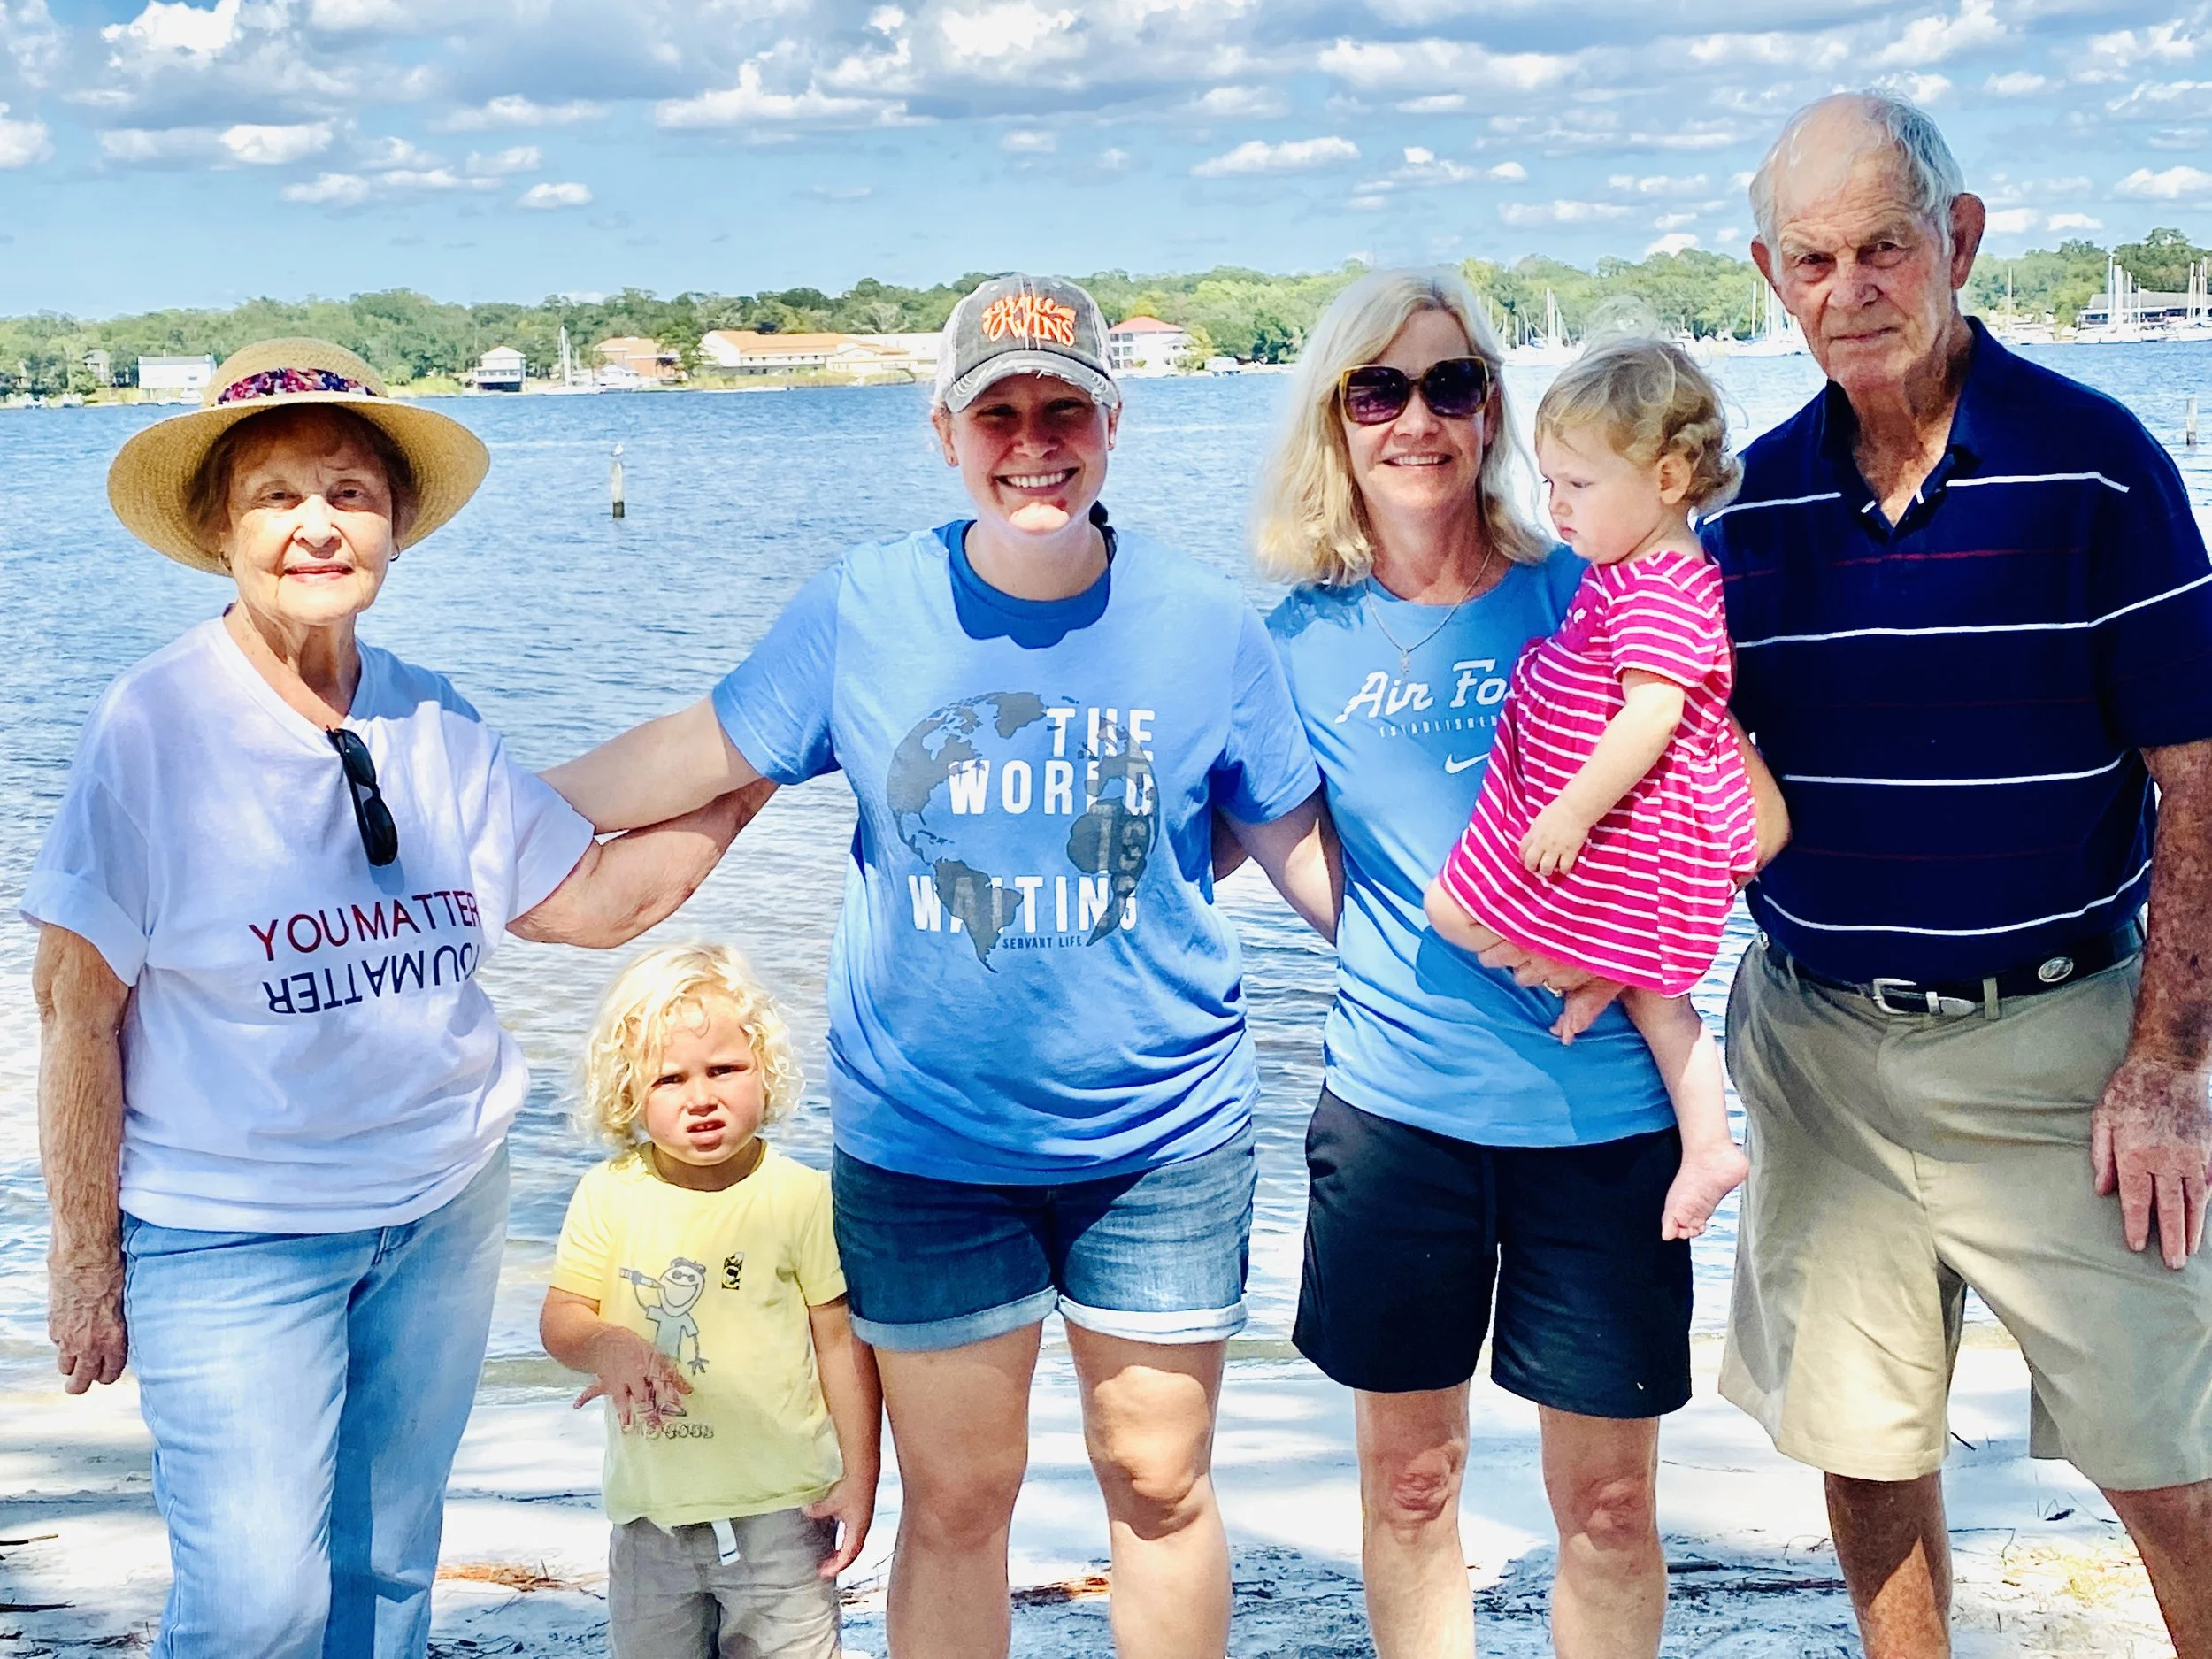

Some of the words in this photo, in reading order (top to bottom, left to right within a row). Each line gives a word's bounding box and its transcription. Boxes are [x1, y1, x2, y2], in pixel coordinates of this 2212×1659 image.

[1334, 670, 1434, 724] Air
[1449, 658, 1507, 708] Fo
[1046, 707, 1156, 761] THE
[908, 874, 1138, 933] WAITING
[1002, 937, 1053, 949] SERVANT
[1059, 935, 1082, 948] LIFE
